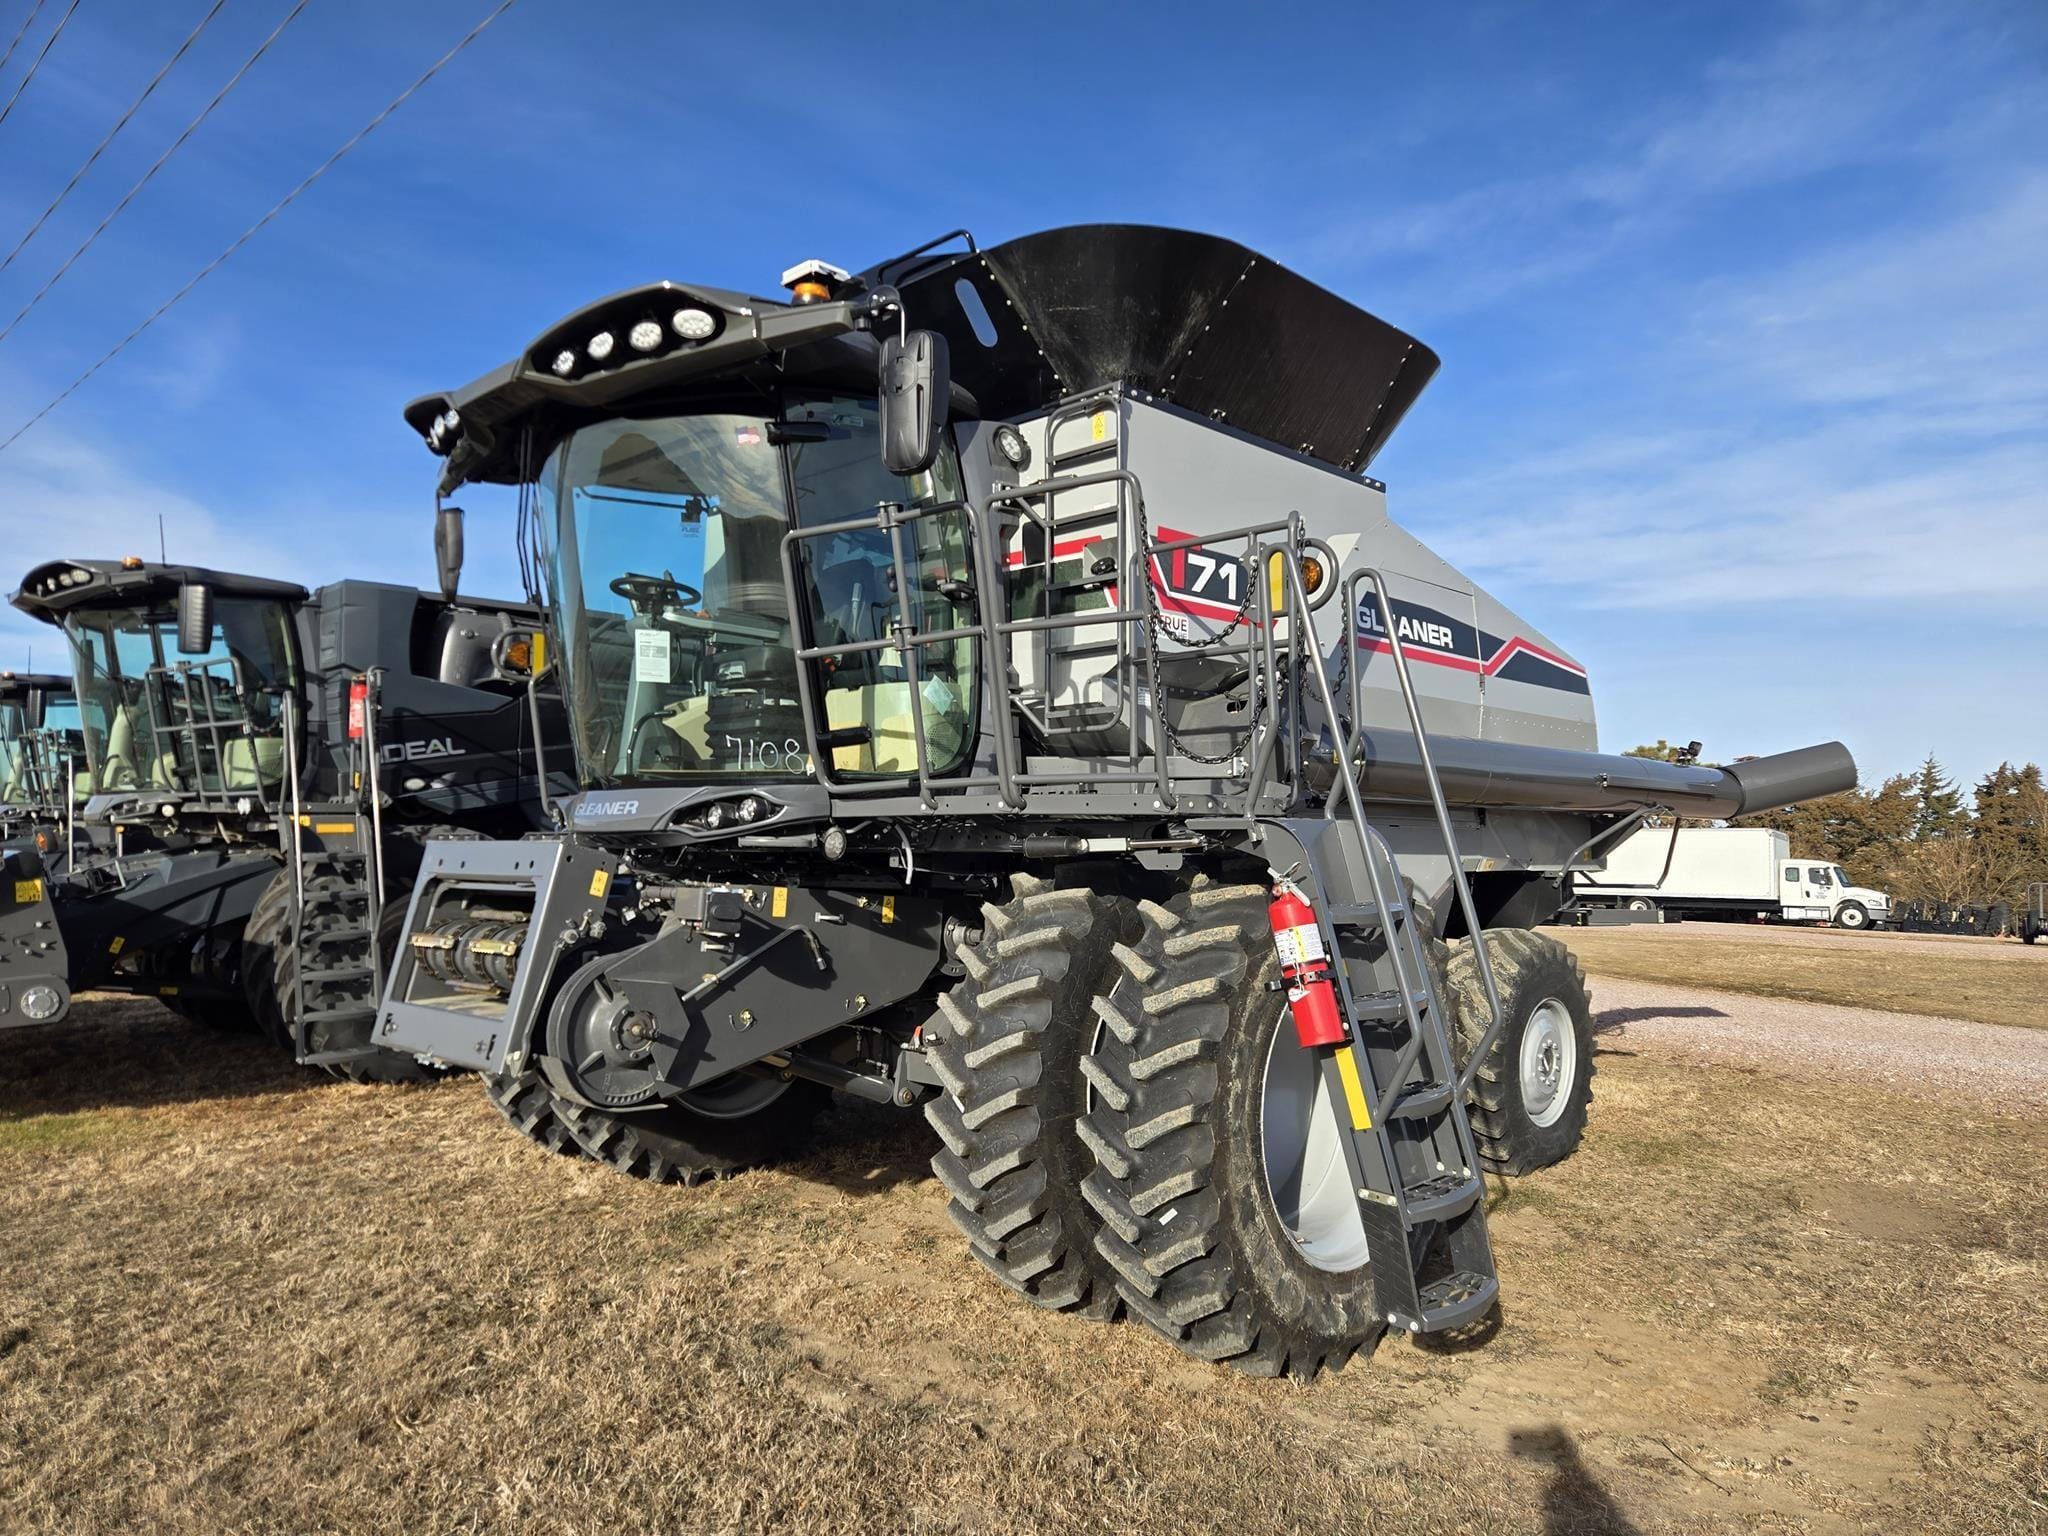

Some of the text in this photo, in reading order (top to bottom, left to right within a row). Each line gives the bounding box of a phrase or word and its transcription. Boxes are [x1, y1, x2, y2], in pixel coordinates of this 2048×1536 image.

[1356, 606, 1453, 649] GLANER
[725, 734, 804, 775] 7108
[575, 800, 639, 816] GLEANER
